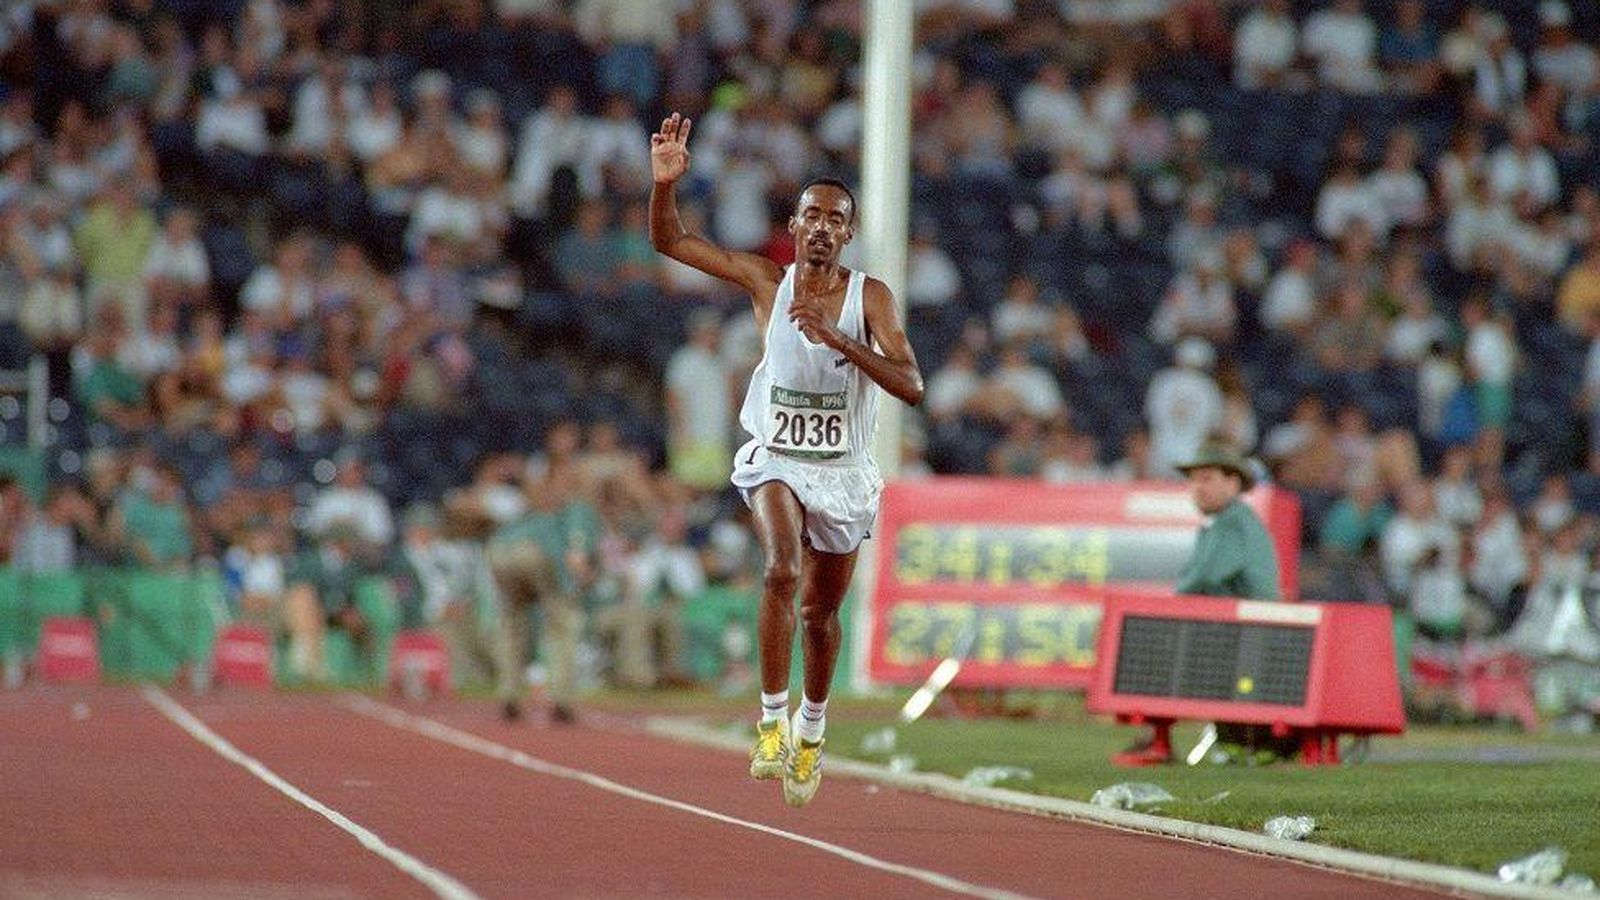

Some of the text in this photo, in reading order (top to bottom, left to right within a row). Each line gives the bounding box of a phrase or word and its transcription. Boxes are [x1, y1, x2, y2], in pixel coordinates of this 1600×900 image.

[775, 389, 844, 409] Atlanta 1996
[772, 411, 842, 447] 2036
[897, 522, 1109, 588] 34:34
